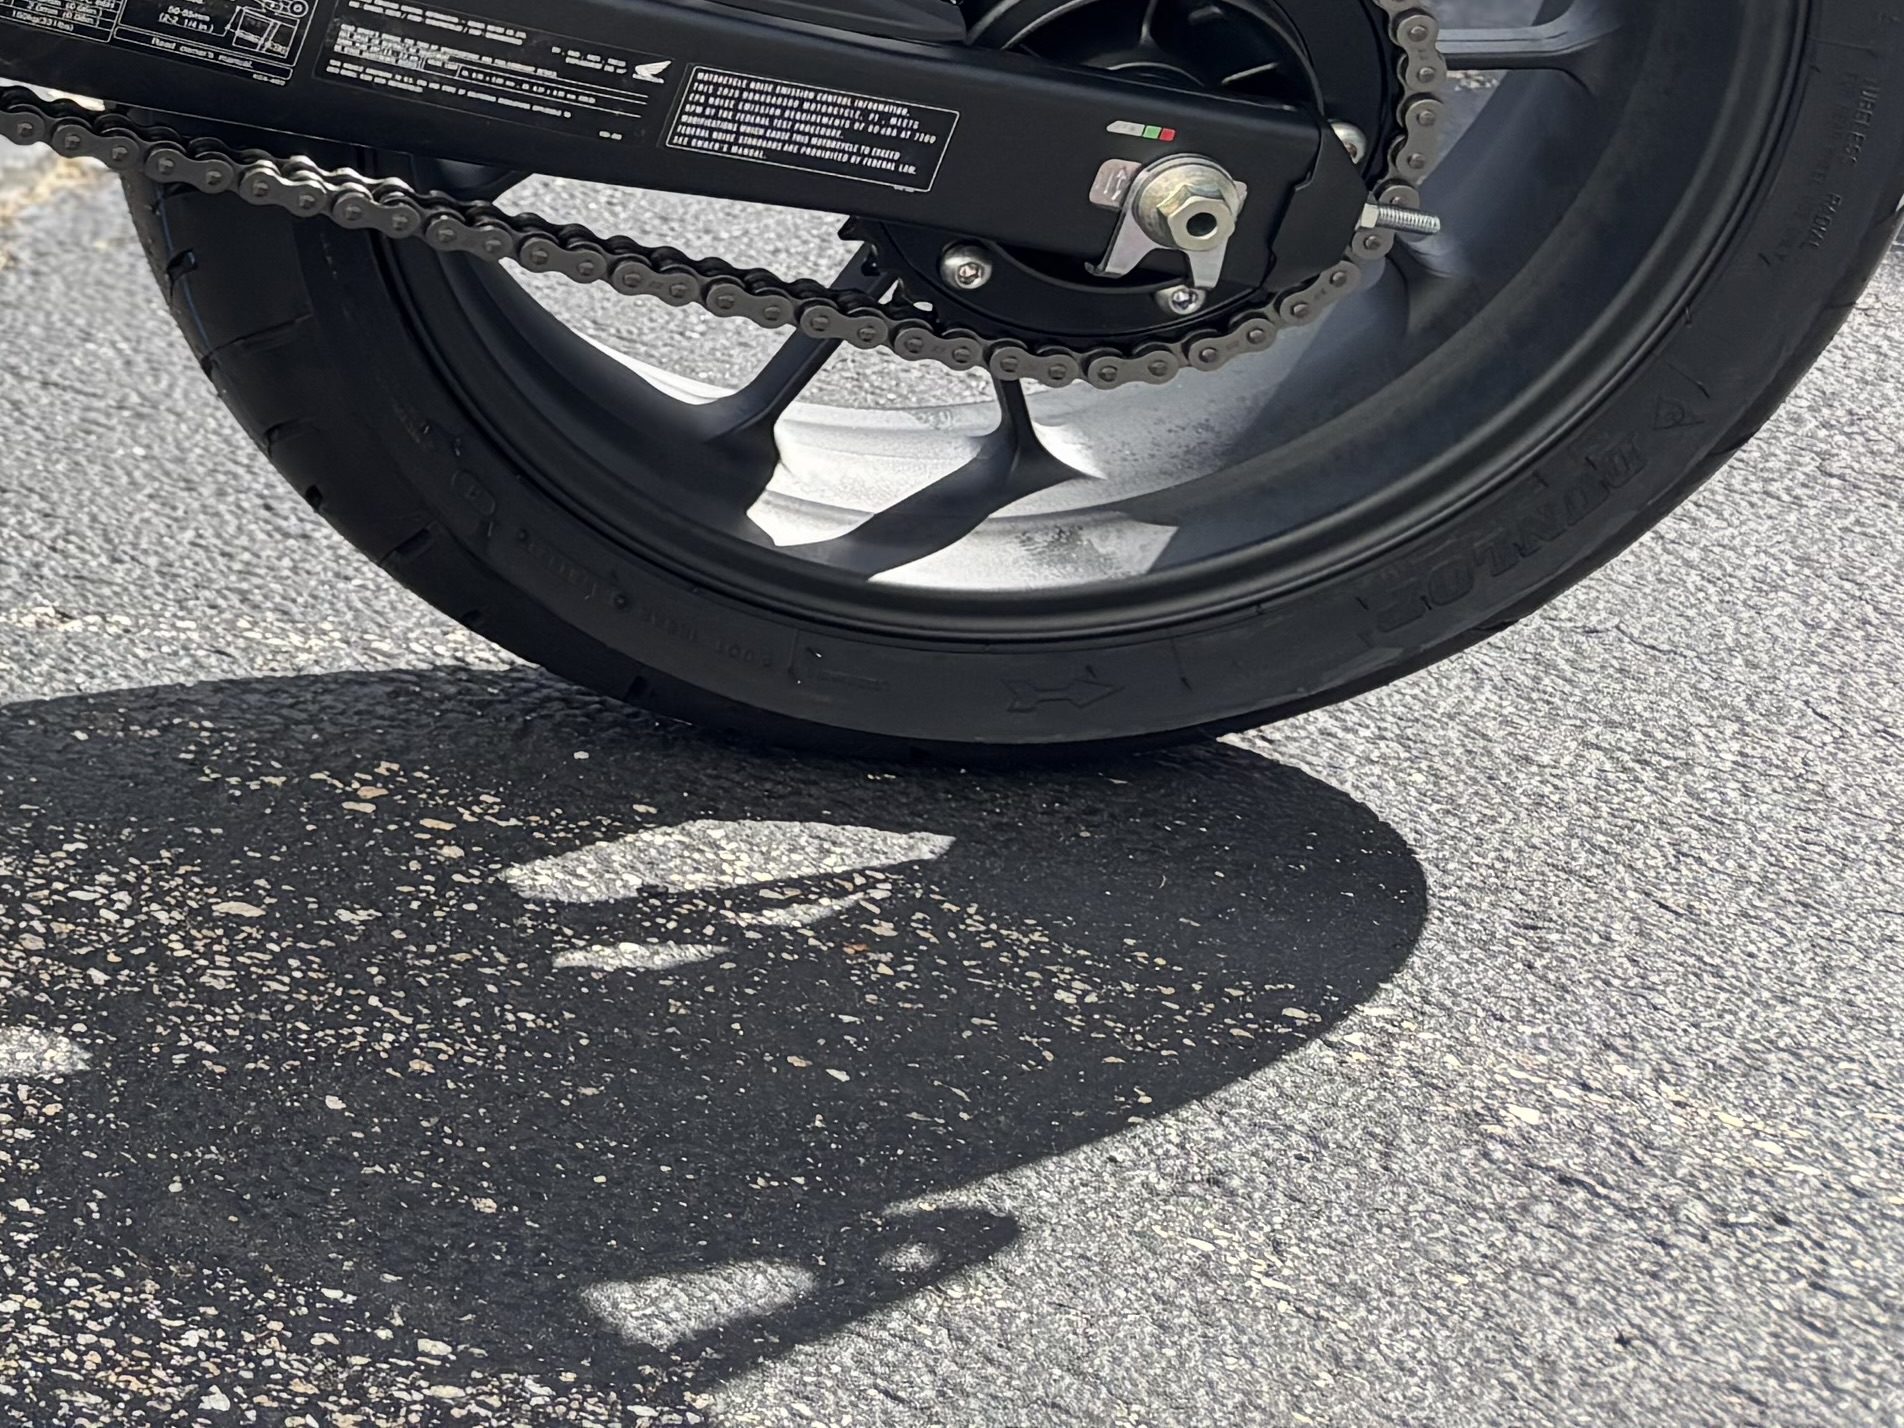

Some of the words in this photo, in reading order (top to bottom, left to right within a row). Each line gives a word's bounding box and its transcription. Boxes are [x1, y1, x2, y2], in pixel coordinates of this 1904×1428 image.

[151, 37, 177, 50] Read
[179, 44, 215, 60] owner's
[693, 82, 714, 94] THIS
[697, 72, 748, 89] MOTORCYCLE
[749, 81, 774, 93] NOISE
[775, 85, 815, 100] EMISSION
[816, 92, 852, 107] CONTROL
[684, 103, 704, 114] RPM
[704, 106, 716, 116] BY
[718, 109, 734, 120] THE
[735, 112, 770, 126] FEDERAL
[773, 118, 793, 129] TEST
[689, 92, 705, 104] EPA
[708, 96, 735, 109] NOISE
[738, 101, 782, 116] EMISSION
[784, 109, 851, 129] REQUIREMENTS
[853, 121, 865, 131] OF
[900, 129, 912, 140] AT
[673, 135, 689, 145] SEE
[691, 138, 729, 152] OWNER'S
[676, 124, 710, 138] FEDERAL
[712, 130, 736, 142] NOISE
[738, 135, 783, 151] STANDARDS
[783, 143, 799, 154] ARE
[800, 146, 849, 163] PROHIBITED
[850, 155, 862, 164] BY
[862, 157, 896, 171] FEDERAL
[681, 114, 738, 132] MODIFICATIONS
[739, 124, 765, 136] WHICH
[766, 128, 791, 141] CAUSE
[792, 132, 810, 144] THIS
[810, 136, 859, 153] MOTORCYCLE
[860, 145, 871, 155] TO
[871, 147, 901, 161] EXCEED
